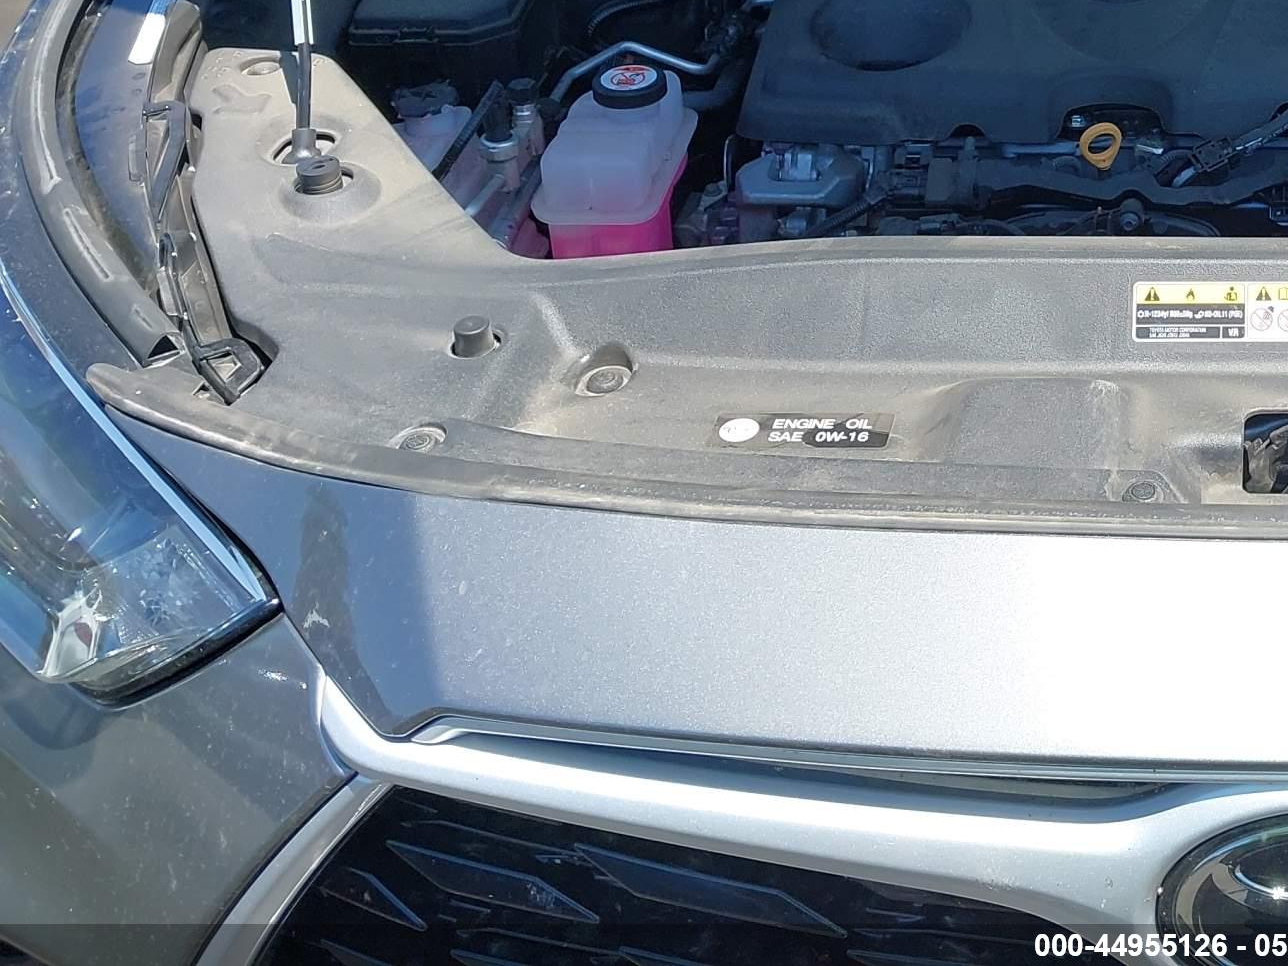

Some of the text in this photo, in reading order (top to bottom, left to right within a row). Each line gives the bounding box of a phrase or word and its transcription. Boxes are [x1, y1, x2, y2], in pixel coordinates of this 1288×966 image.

[772, 418, 873, 430] ENGINE OIL
[767, 431, 870, 442] SAE 0W-16
